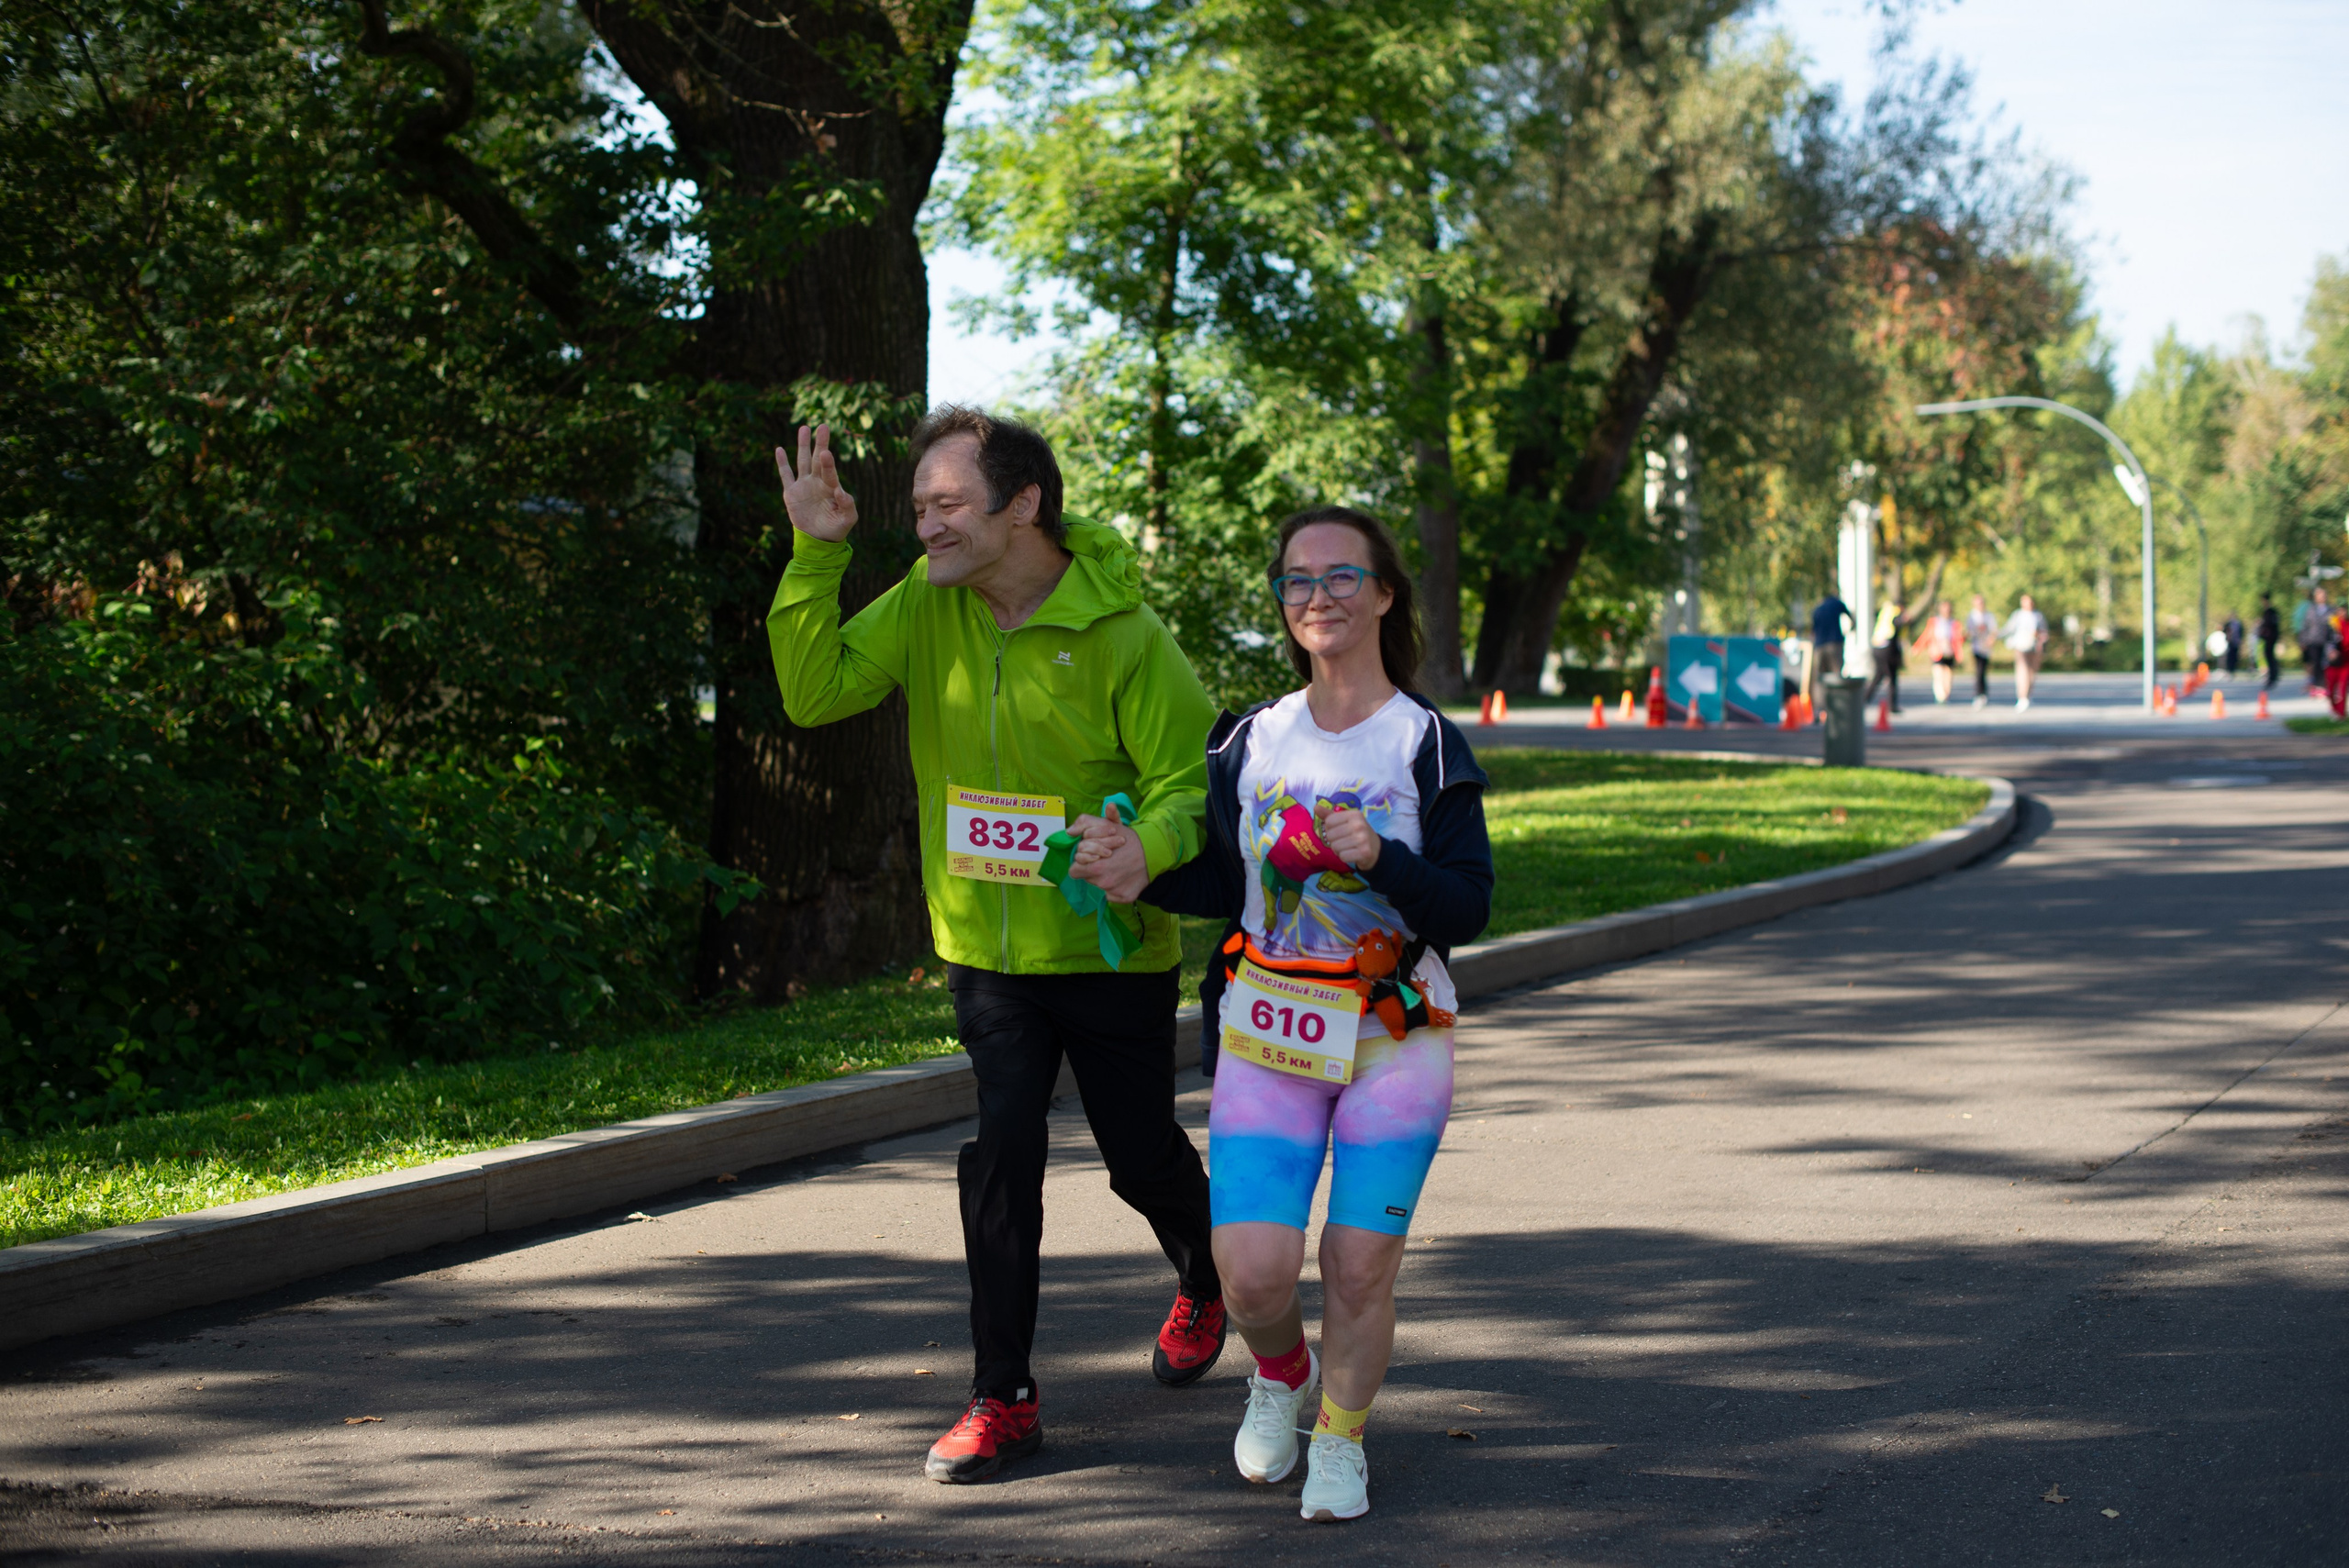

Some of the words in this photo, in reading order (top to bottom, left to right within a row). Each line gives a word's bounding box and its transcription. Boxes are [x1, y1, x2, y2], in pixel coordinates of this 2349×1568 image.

[960, 792, 1019, 807] ИНКЛЮЗИВНЫЙ
[1020, 799, 1047, 809] ЗАБЕГ
[968, 817, 1040, 852] 832
[985, 862, 1007, 878] 5,5
[1246, 968, 1310, 995] ИНКЛЮЗИВНЫЙ
[1312, 987, 1342, 1002] ЗАБЕГ
[1251, 999, 1326, 1043] 610
[1262, 1047, 1286, 1064] 5,5
